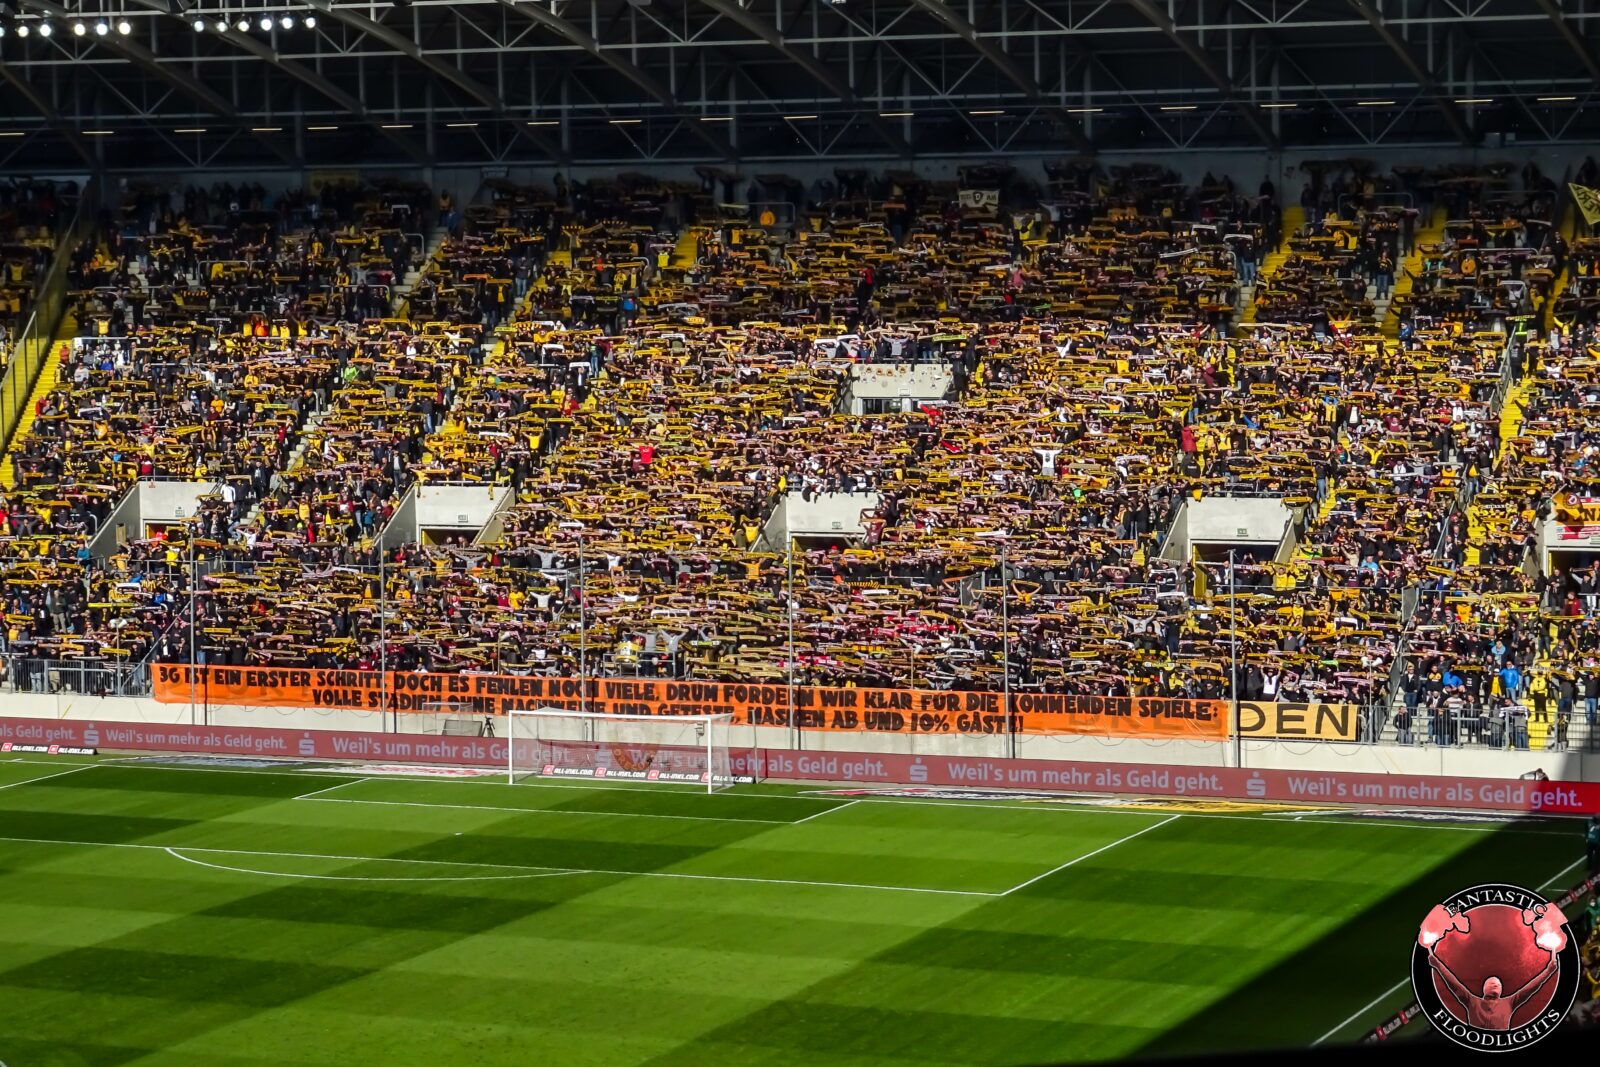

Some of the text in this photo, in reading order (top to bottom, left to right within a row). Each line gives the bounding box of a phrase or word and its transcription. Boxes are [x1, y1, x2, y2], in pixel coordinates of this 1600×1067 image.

[159, 666, 180, 683] 3G
[184, 667, 209, 685] IST
[214, 669, 241, 685] EIN
[246, 670, 311, 687] ERSTER
[395, 674, 442, 692] DOCH
[448, 675, 470, 693] ES
[476, 677, 543, 697] FEHLEN
[549, 680, 599, 697] NOCH
[666, 683, 718, 702] DRUM
[723, 685, 814, 707] FORDERN
[820, 690, 857, 708] WIR
[864, 691, 912, 710] KLAR
[921, 692, 962, 712] FÜR
[966, 693, 999, 713] DIE
[1008, 694, 1132, 716] KOMMENDEN
[313, 689, 362, 706] VOLLE
[368, 691, 441, 712] STADIEN
[448, 694, 495, 713] OHNE
[613, 703, 652, 717] UND
[747, 706, 825, 728] MASKEN
[831, 710, 859, 729] AB
[864, 711, 904, 730] UND
[911, 713, 949, 732] 10%
[16, 725, 43, 738] Geld
[46, 727, 77, 742] geht.
[106, 728, 287, 751] Weil's um mehr als Geld geht.
[332, 737, 381, 754] Weil's
[385, 743, 411, 756] um
[415, 740, 459, 757] mehr
[462, 742, 484, 758] als
[631, 750, 683, 768] Wil's
[769, 755, 793, 772] als
[797, 756, 838, 774] Geld
[842, 758, 888, 778] geht.
[948, 763, 1223, 793] Weil's um mehr als Geld geht.
[1288, 777, 1583, 808] Weil's um mehr als Geld geht.
